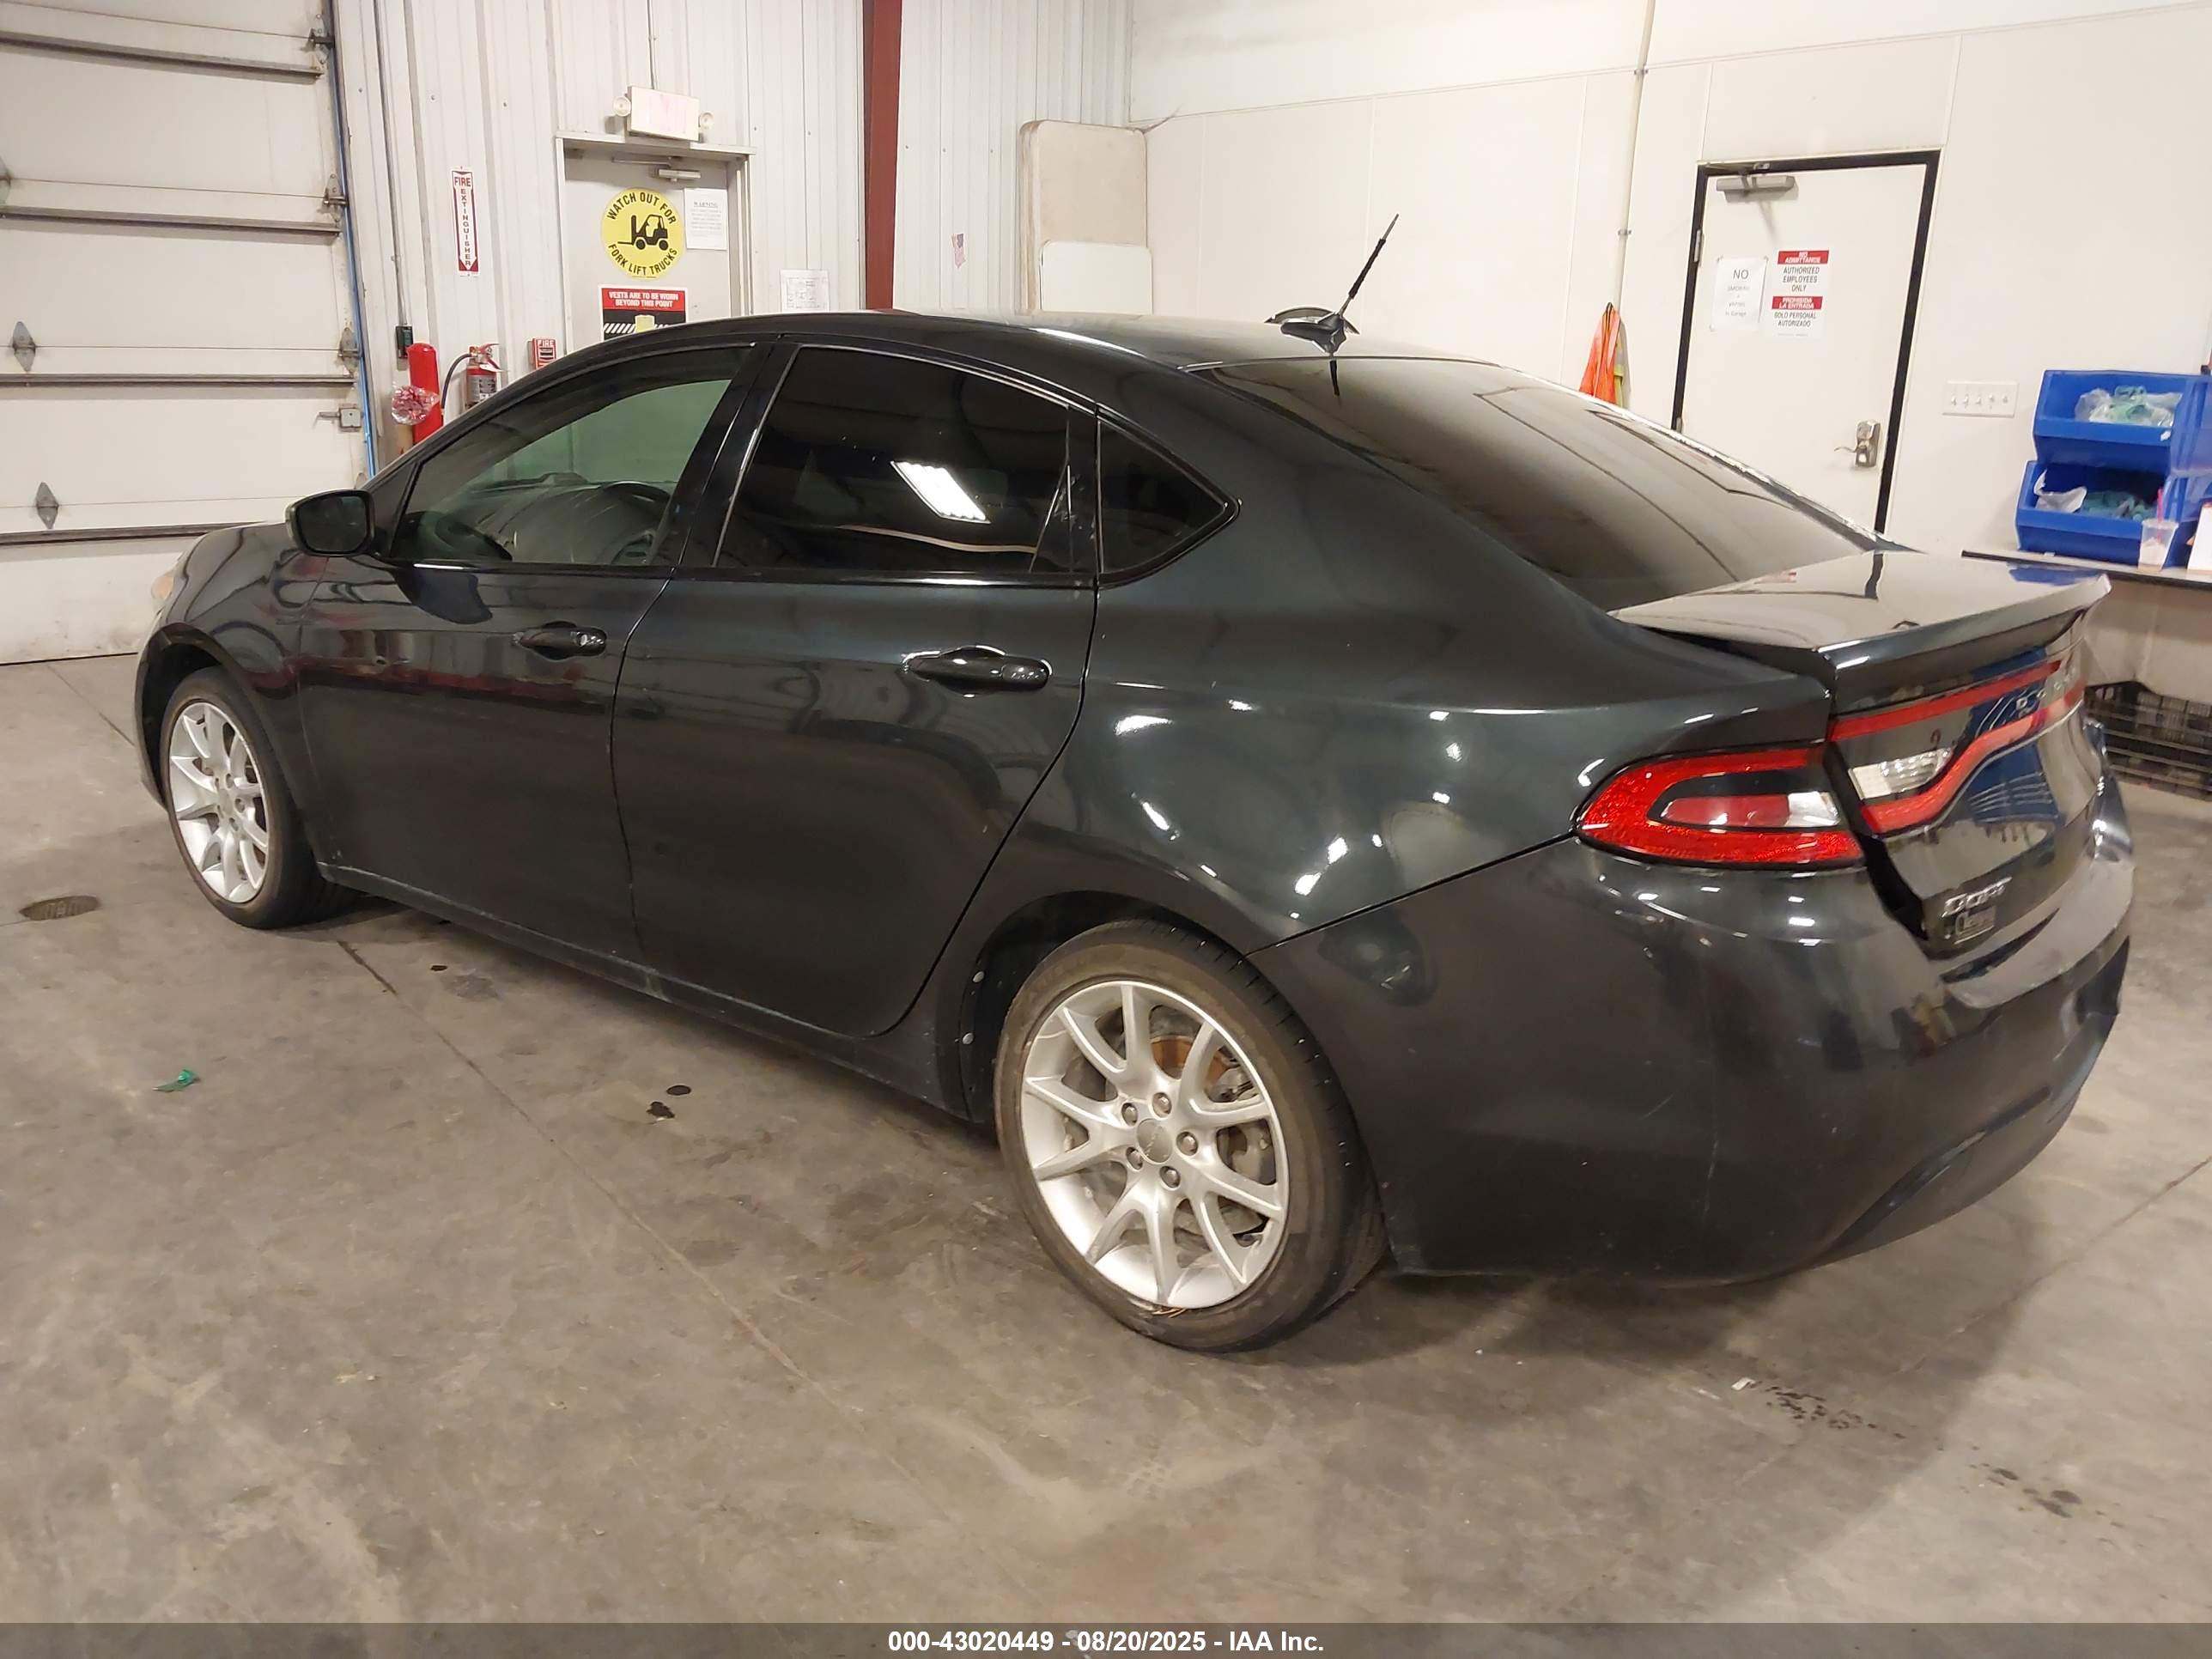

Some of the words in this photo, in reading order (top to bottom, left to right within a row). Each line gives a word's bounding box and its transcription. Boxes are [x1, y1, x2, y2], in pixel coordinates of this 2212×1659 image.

[453, 176, 471, 187] FIRE
[607, 191, 636, 220] WATCH
[640, 191, 659, 206] OUT
[659, 203, 677, 224] FOR
[460, 188, 471, 265] EXTINGUISHER
[608, 243, 629, 268] FORK
[628, 263, 647, 276] LIFT
[649, 247, 678, 275] TRUCKS
[1733, 269, 1749, 280] NO
[1783, 275, 1817, 283] EMPLOYEES
